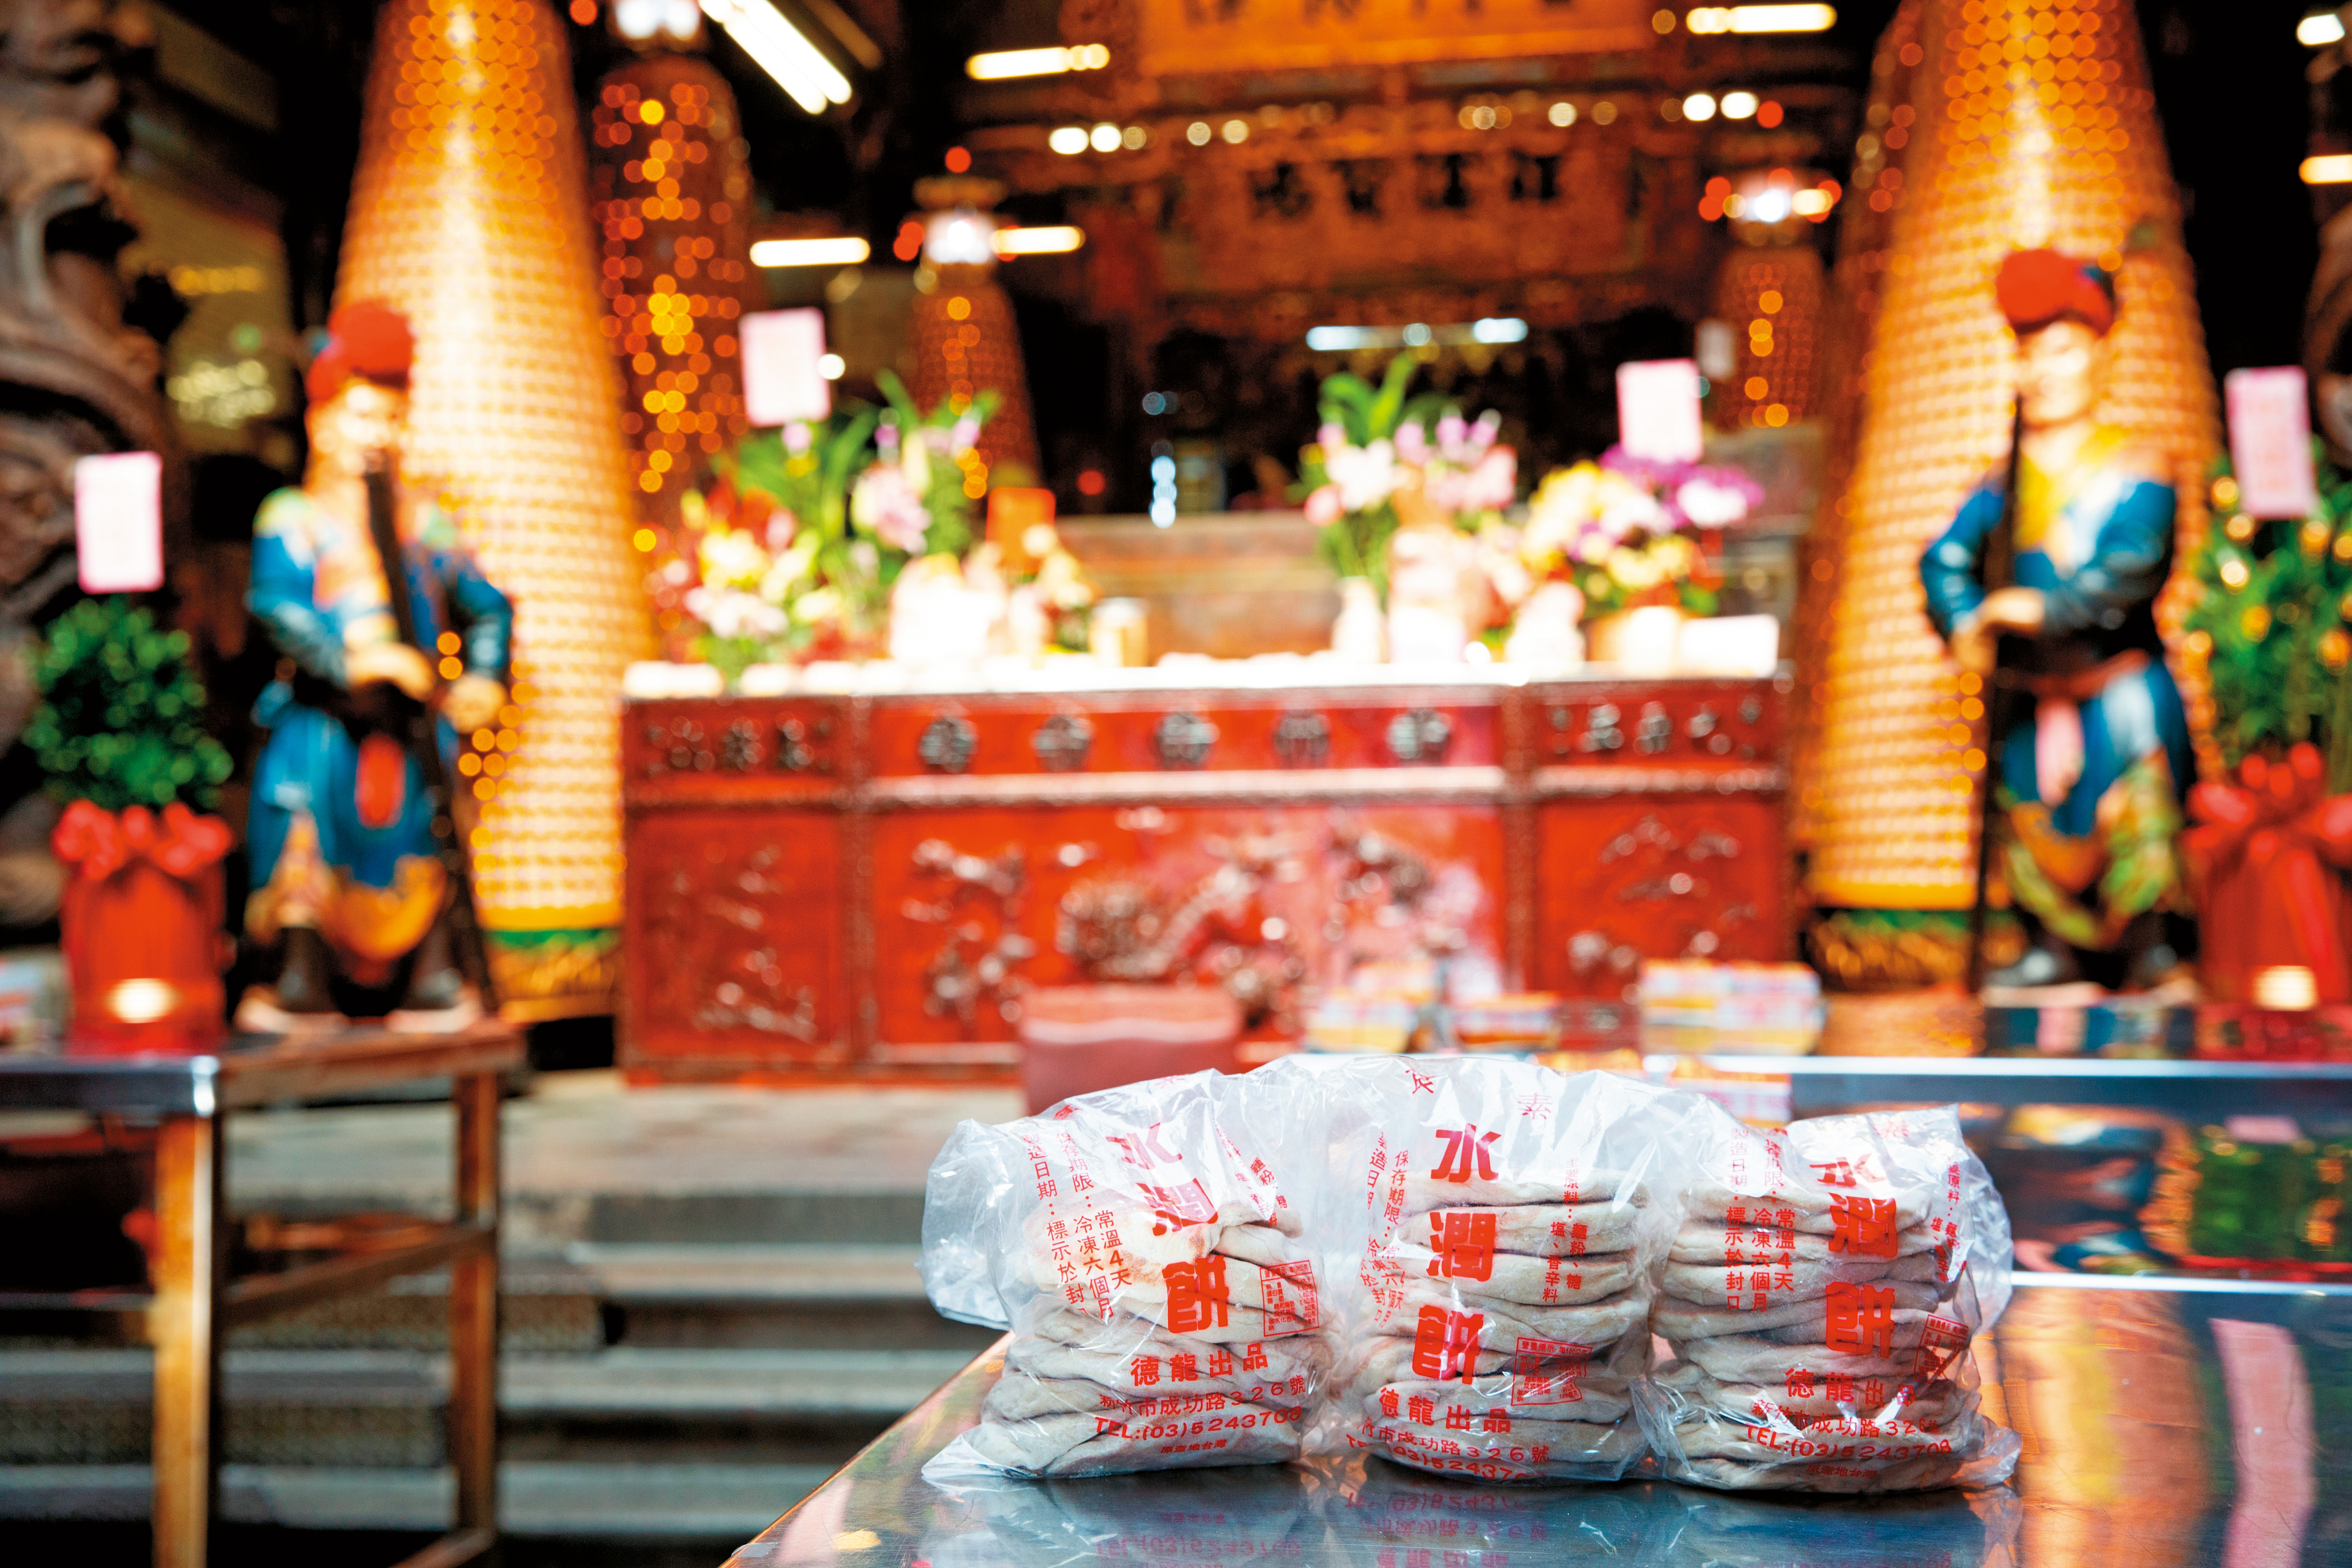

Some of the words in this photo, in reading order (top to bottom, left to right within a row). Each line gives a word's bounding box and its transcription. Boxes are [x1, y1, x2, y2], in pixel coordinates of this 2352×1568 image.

[1518, 1093, 1553, 1120] 素
[1095, 1209, 1132, 1290] 常溫4天
[1412, 1123, 1502, 1385] 水潤餅
[1750, 1207, 1772, 1313] 冷凍六個月
[1773, 1208, 1796, 1291] 常溫4天
[1809, 1153, 1898, 1359] 水潤餅
[1099, 1375, 1306, 1417] 新竹市成功路326號
[1130, 1343, 1269, 1386] 德龍出品
[1784, 1368, 1917, 1407] 德龍出品
[1379, 1387, 1511, 1433] 德龍出品
